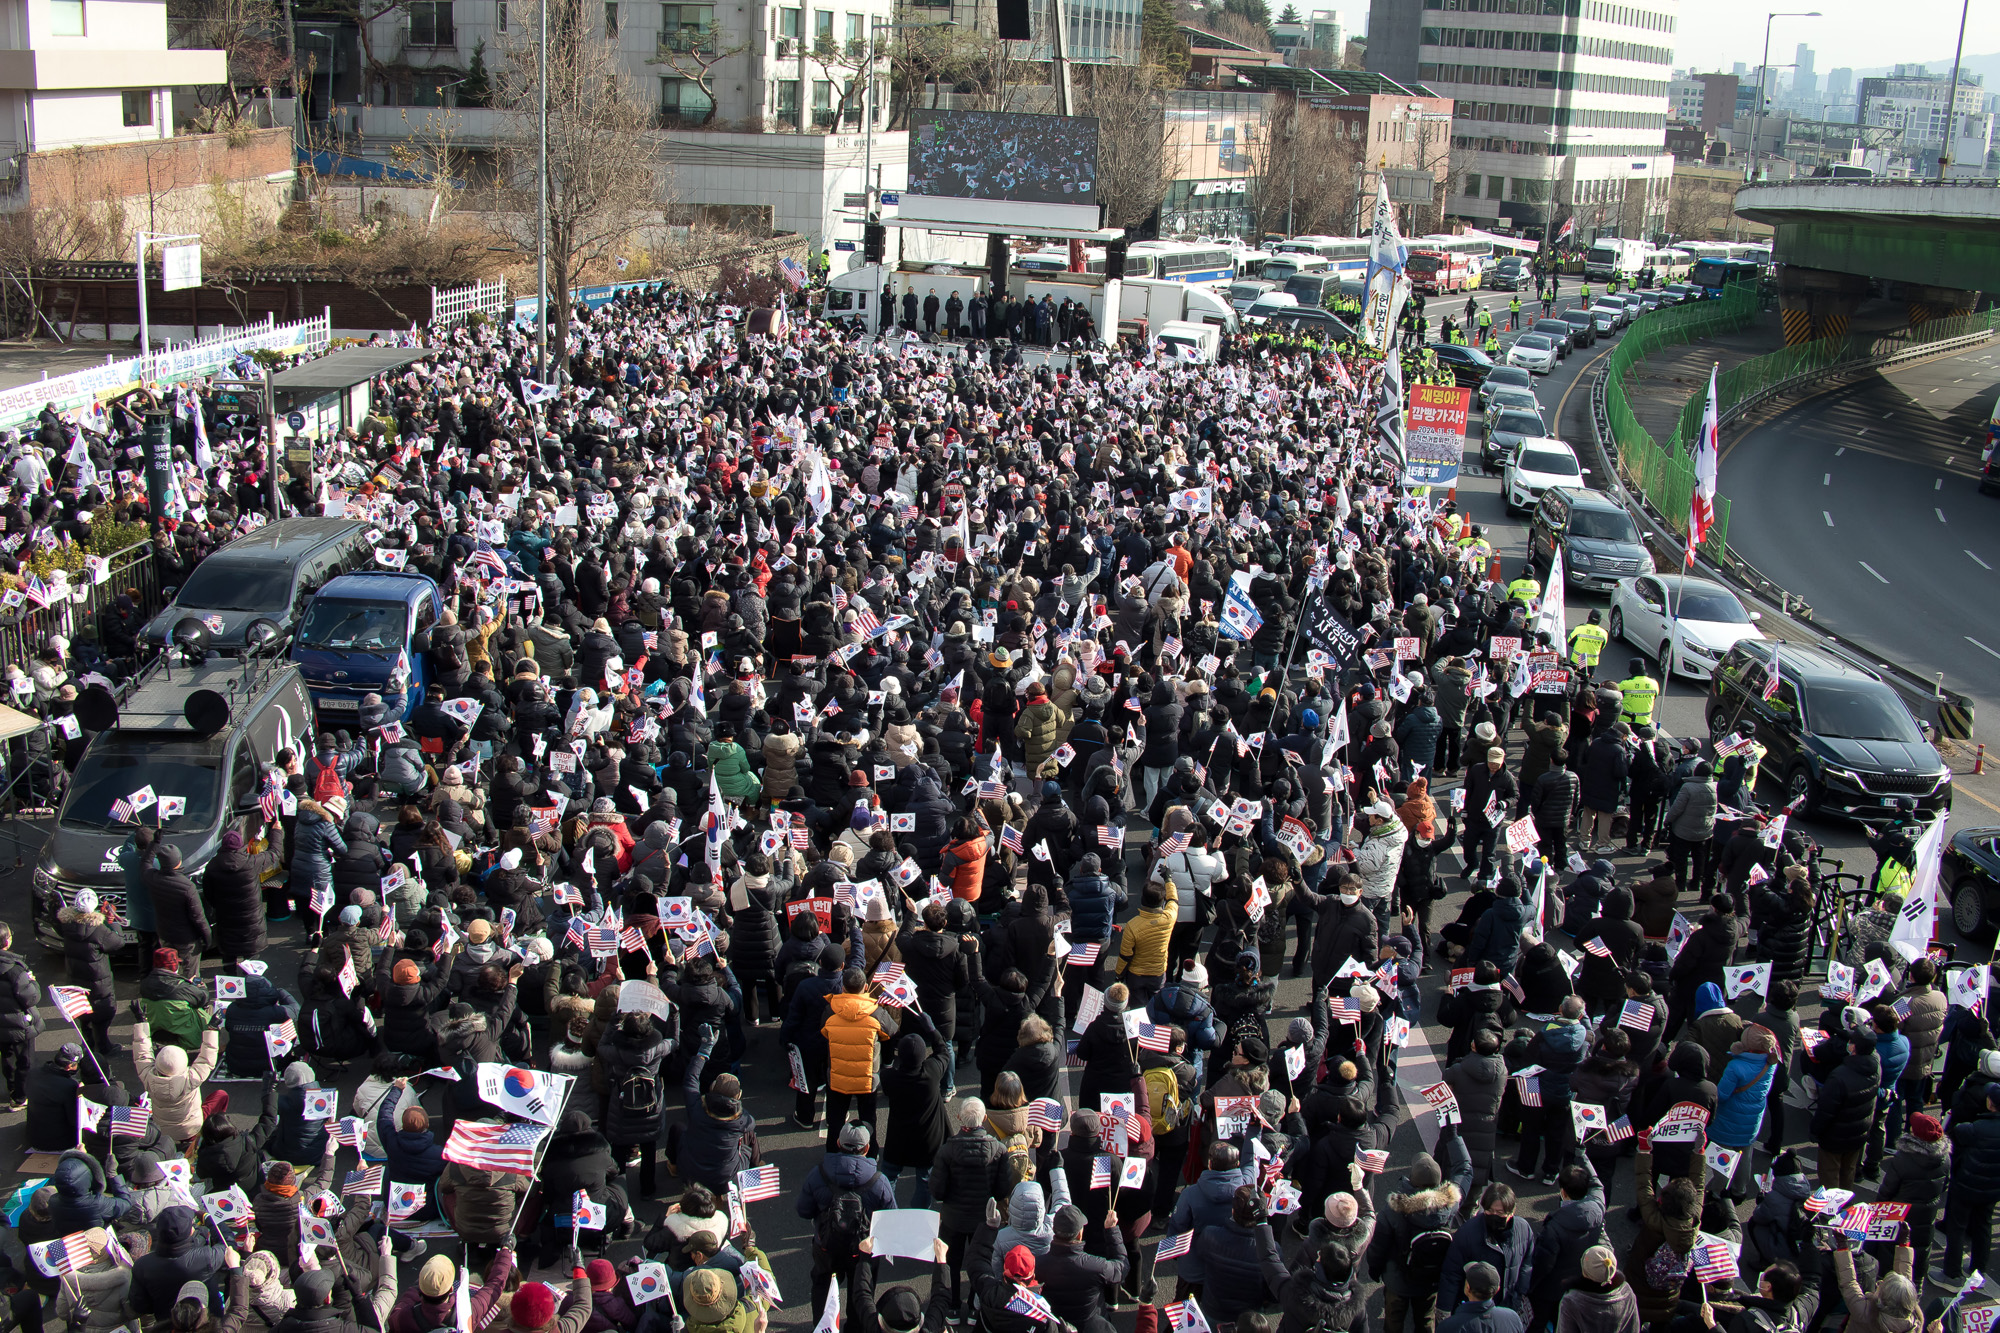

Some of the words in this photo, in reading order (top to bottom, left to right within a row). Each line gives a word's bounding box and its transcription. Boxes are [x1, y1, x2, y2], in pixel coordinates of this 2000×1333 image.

[1212, 181, 1246, 194] AMG
[35, 380, 78, 403] 루터대학교
[80, 374, 104, 391] 신입생
[1421, 389, 1460, 405] 재명아!
[1412, 407, 1465, 424] 깜빵가자!
[1326, 616, 1359, 650] 부정선거
[1495, 638, 1517, 646] STOP
[555, 752, 573, 760] STOP
[553, 764, 573, 772] STEAL
[1508, 819, 1528, 836] STOP
[1512, 828, 1530, 842] THE
[788, 901, 810, 916] 탄핵
[812, 900, 832, 914] 반대
[1099, 1128, 1115, 1141] HE
[1869, 1225, 1897, 1240] 국회
[1962, 1309, 1993, 1325] TOP
